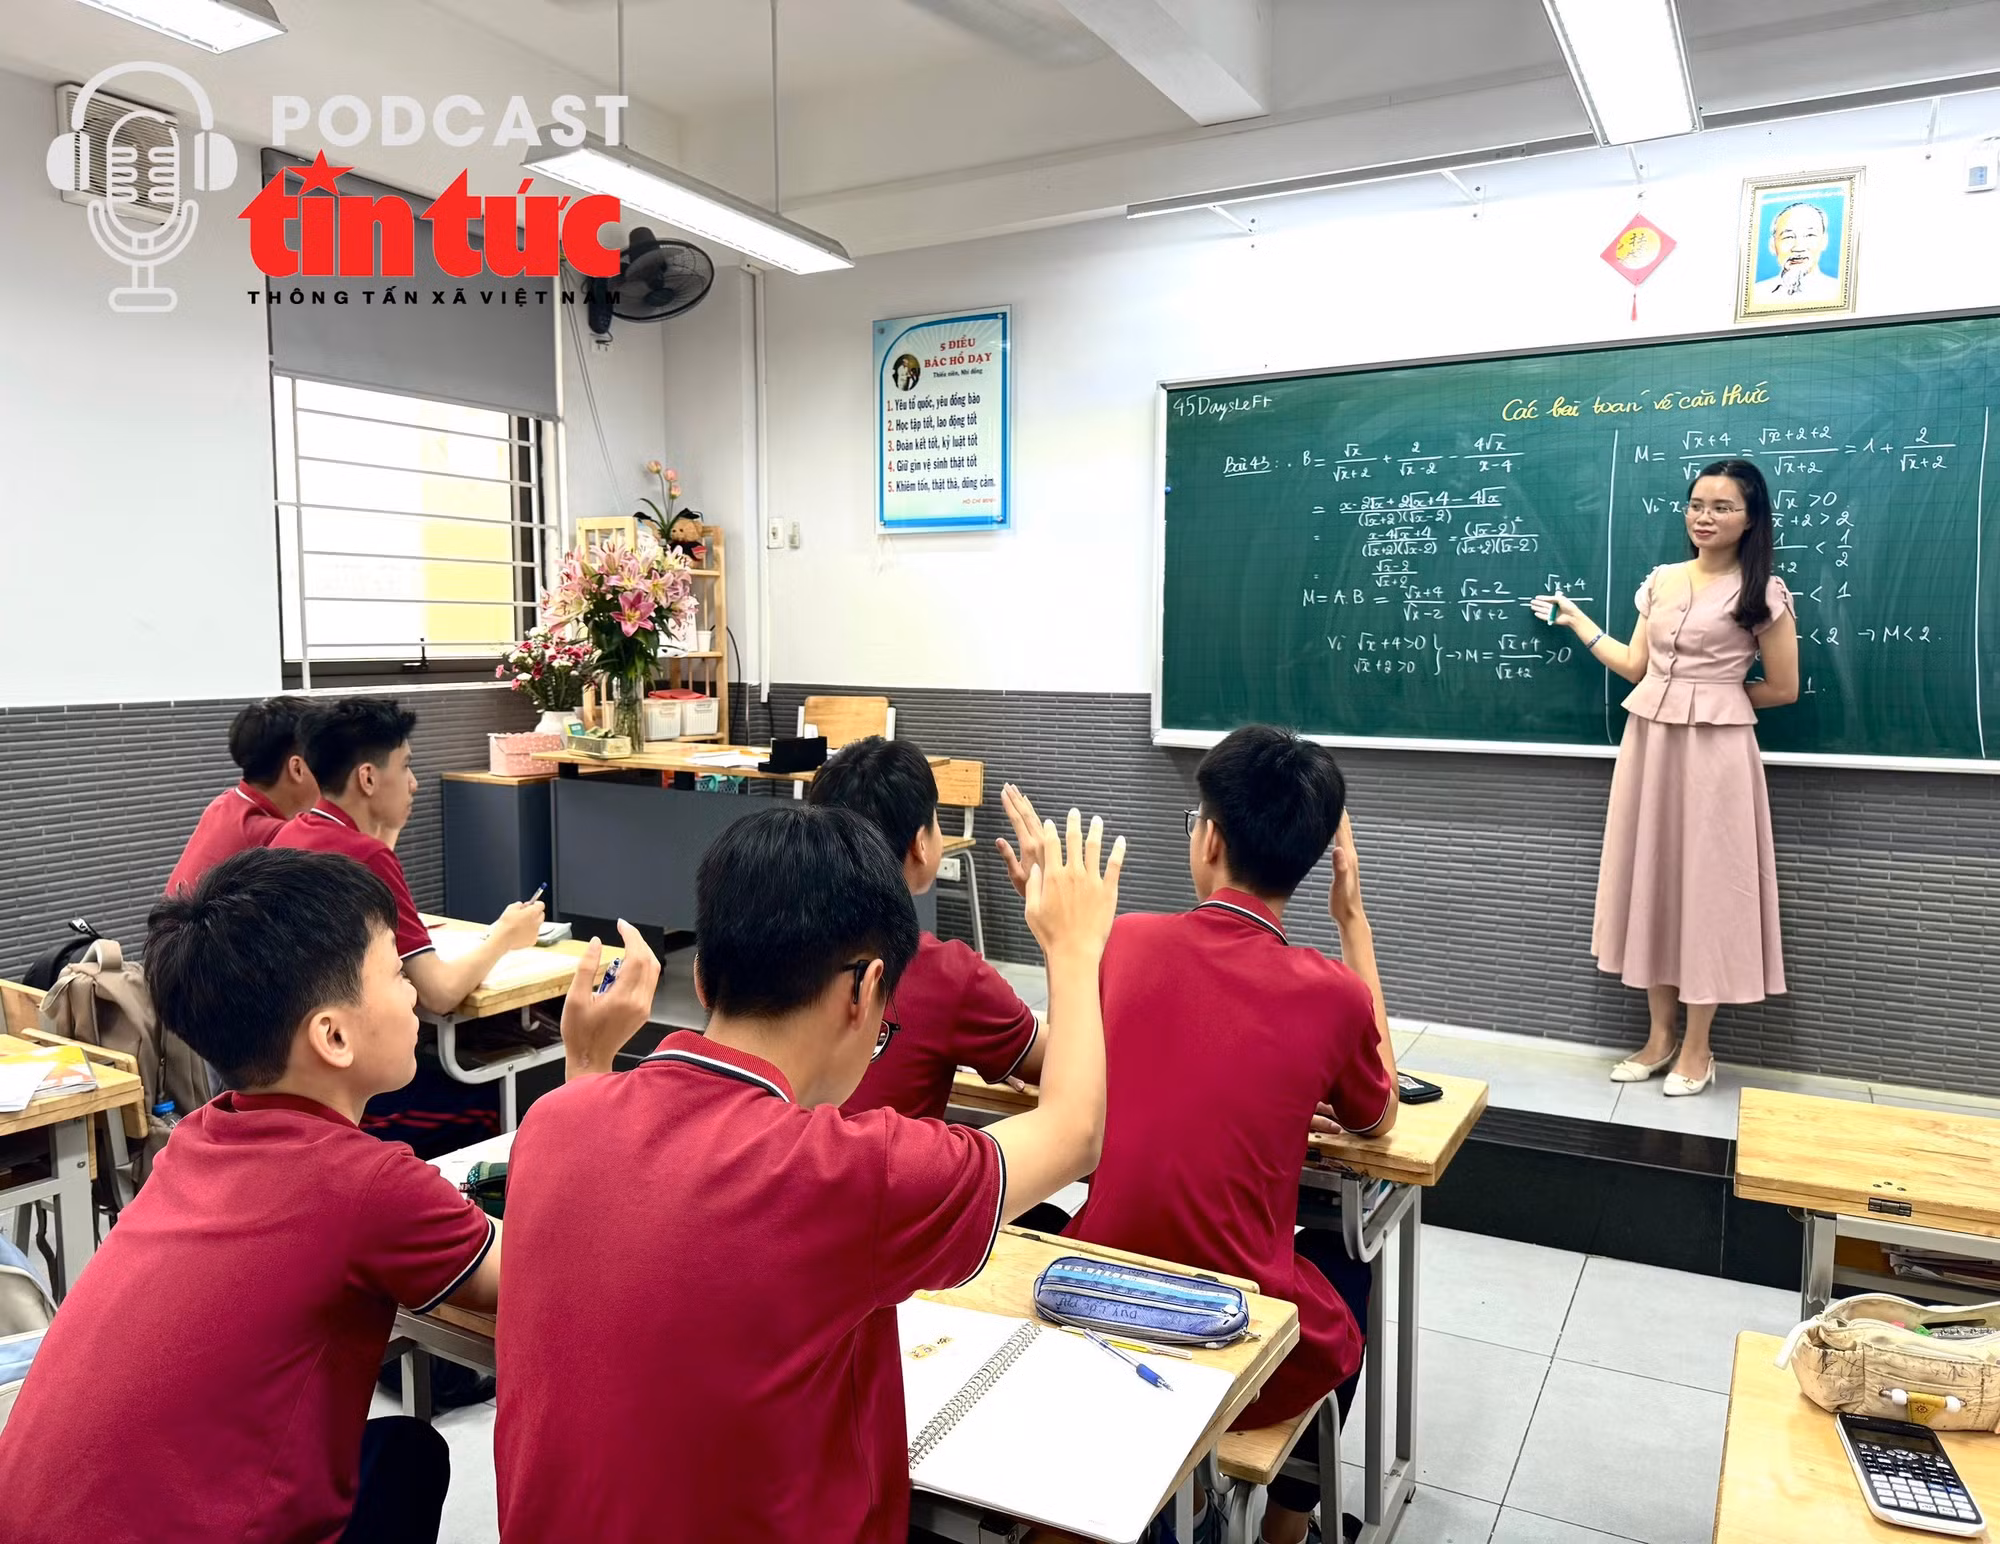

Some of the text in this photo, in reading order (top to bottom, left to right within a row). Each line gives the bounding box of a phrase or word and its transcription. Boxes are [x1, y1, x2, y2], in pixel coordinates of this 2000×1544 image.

[940, 334, 976, 351] 5 ĐIỀU
[924, 351, 992, 368] BÁC HỒ DẠY
[887, 391, 981, 411] 1. Yêu tổ quốc, yêu đồng bào
[1502, 399, 1539, 422] Các
[1721, 380, 1771, 407] thức
[888, 411, 977, 433] 2. Học tập tốt, lao động tốt
[888, 440, 894, 452] 3.
[896, 439, 913, 451] Đoàn
[915, 436, 926, 450] kết
[928, 435, 940, 450] tốt,
[953, 435, 966, 449] luật
[968, 432, 978, 446] tốt
[888, 453, 977, 473] 4. Giữ gìn vệ sinh thật tốt
[888, 481, 894, 492] 5.
[896, 480, 916, 492] Khiêm
[918, 478, 930, 493] tốn,
[932, 478, 945, 492] thật
[962, 476, 977, 490] dũng
